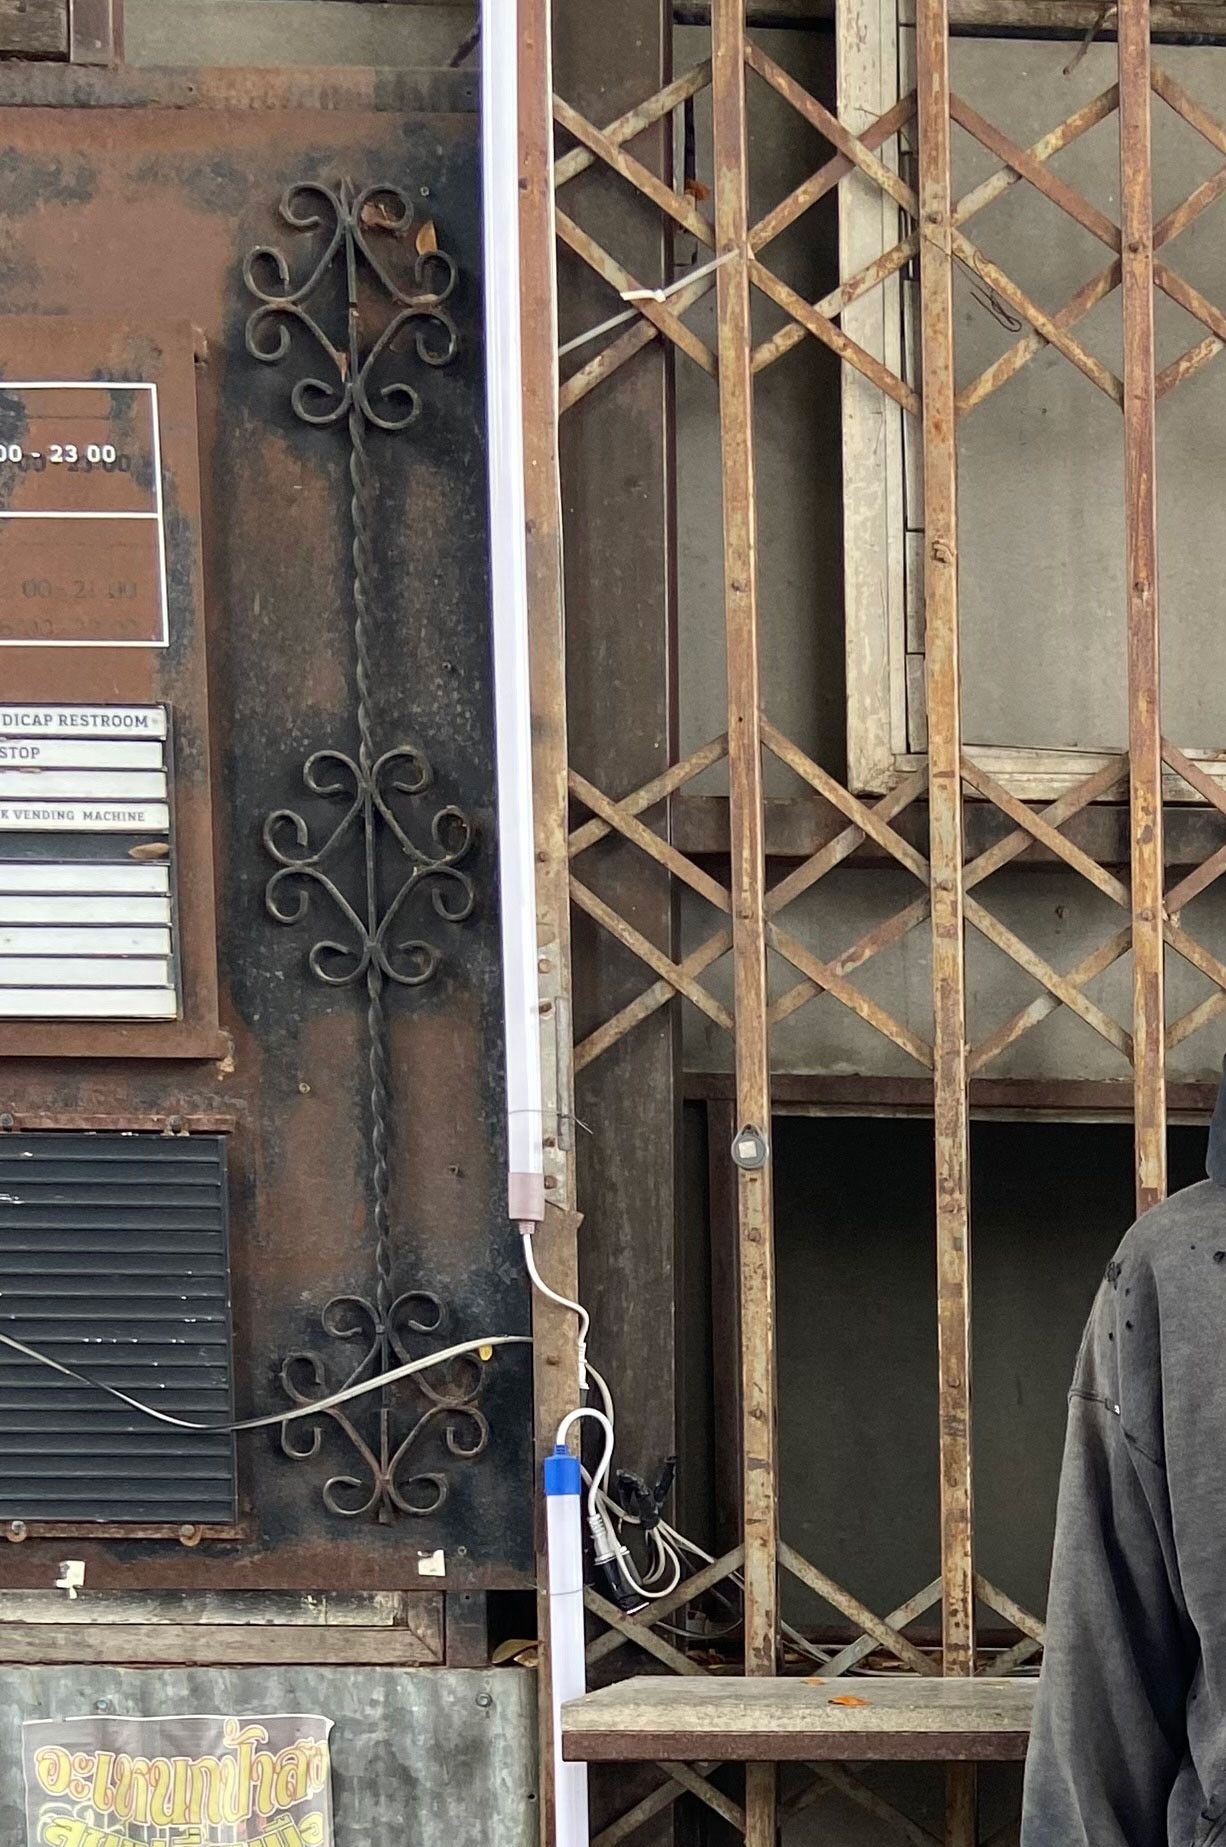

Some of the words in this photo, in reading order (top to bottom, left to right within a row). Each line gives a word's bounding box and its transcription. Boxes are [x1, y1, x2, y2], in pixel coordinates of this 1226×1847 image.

[49, 444, 78, 463] 23
[87, 444, 116, 463] 00
[59, 714, 149, 728] RESTROOM
[0, 746, 41, 760] STOP
[13, 809, 75, 821] VENDING
[83, 810, 145, 822] MACHINE
